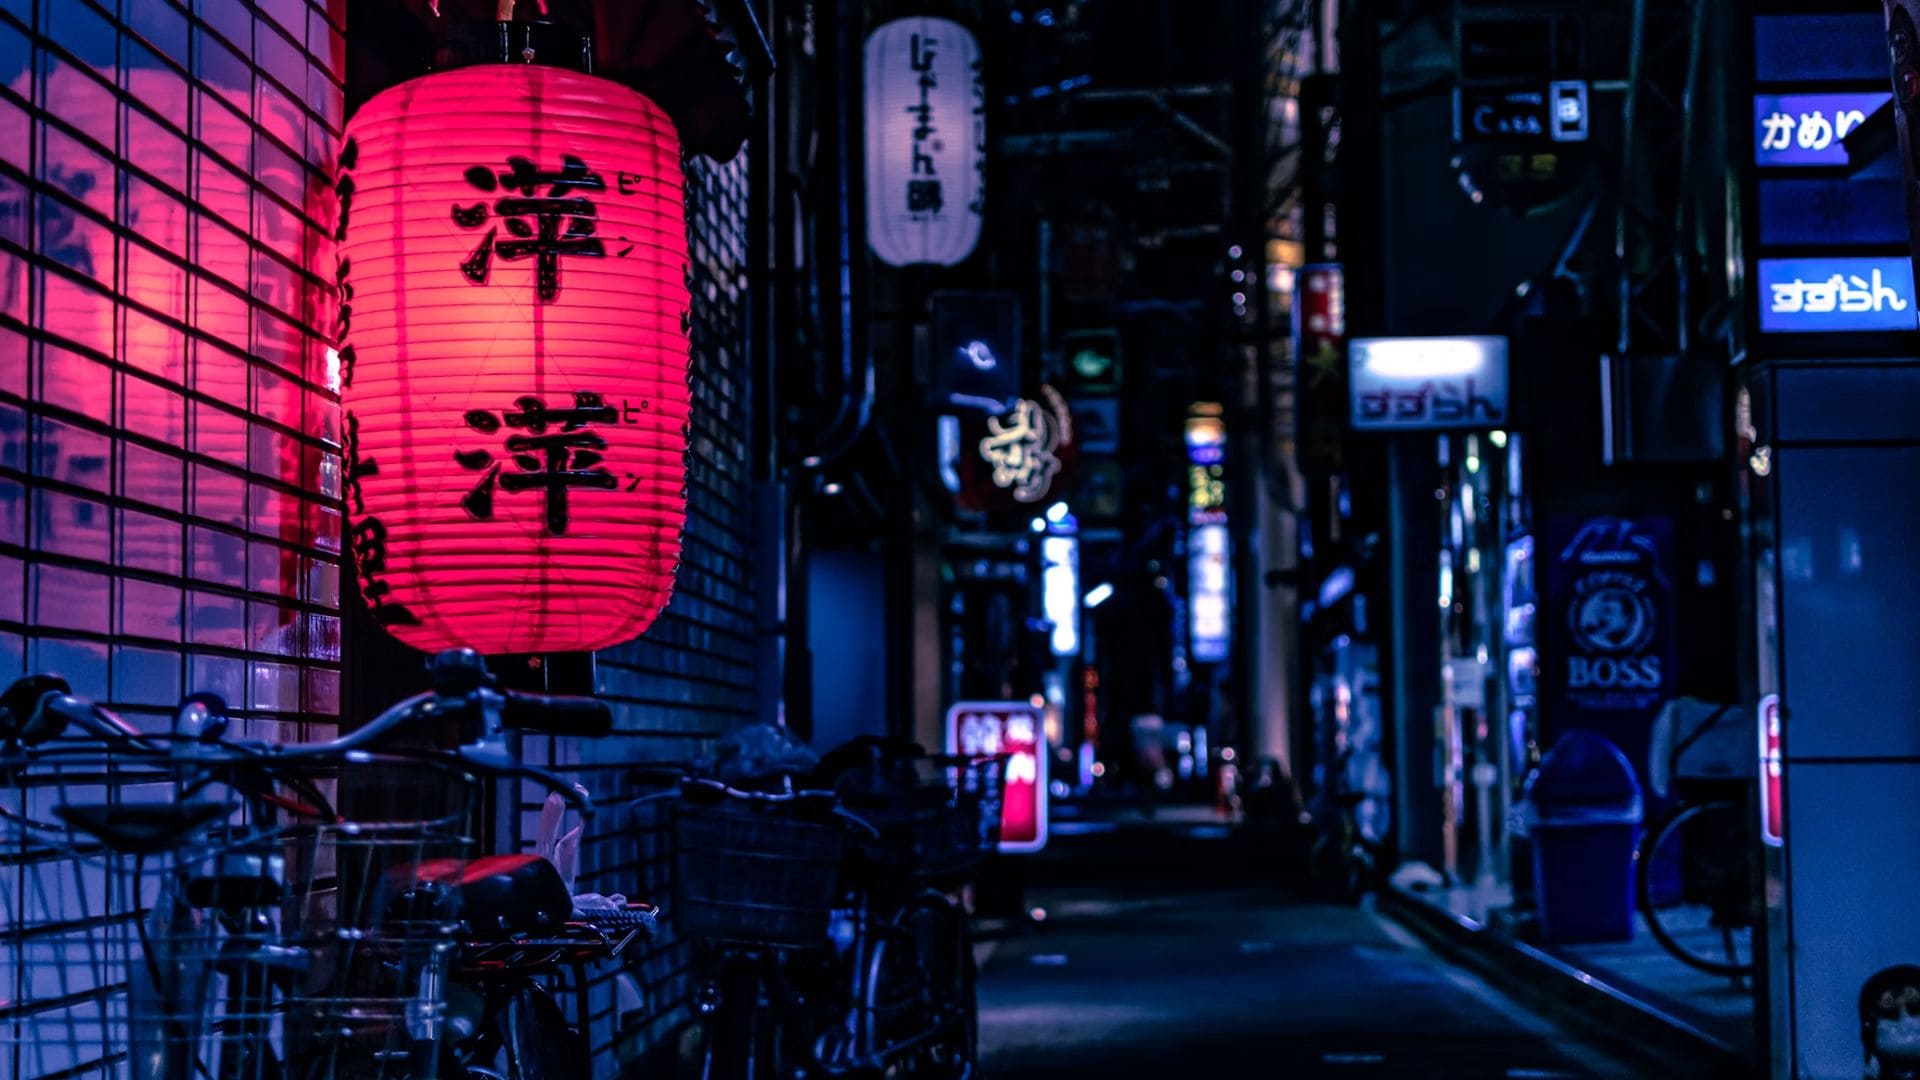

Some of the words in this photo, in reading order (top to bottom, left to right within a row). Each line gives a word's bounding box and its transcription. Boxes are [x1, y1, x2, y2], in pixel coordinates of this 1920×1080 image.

[1770, 267, 1907, 313] すずらん
[1360, 375, 1502, 421] すずらん
[1567, 655, 1662, 689] BOSS
